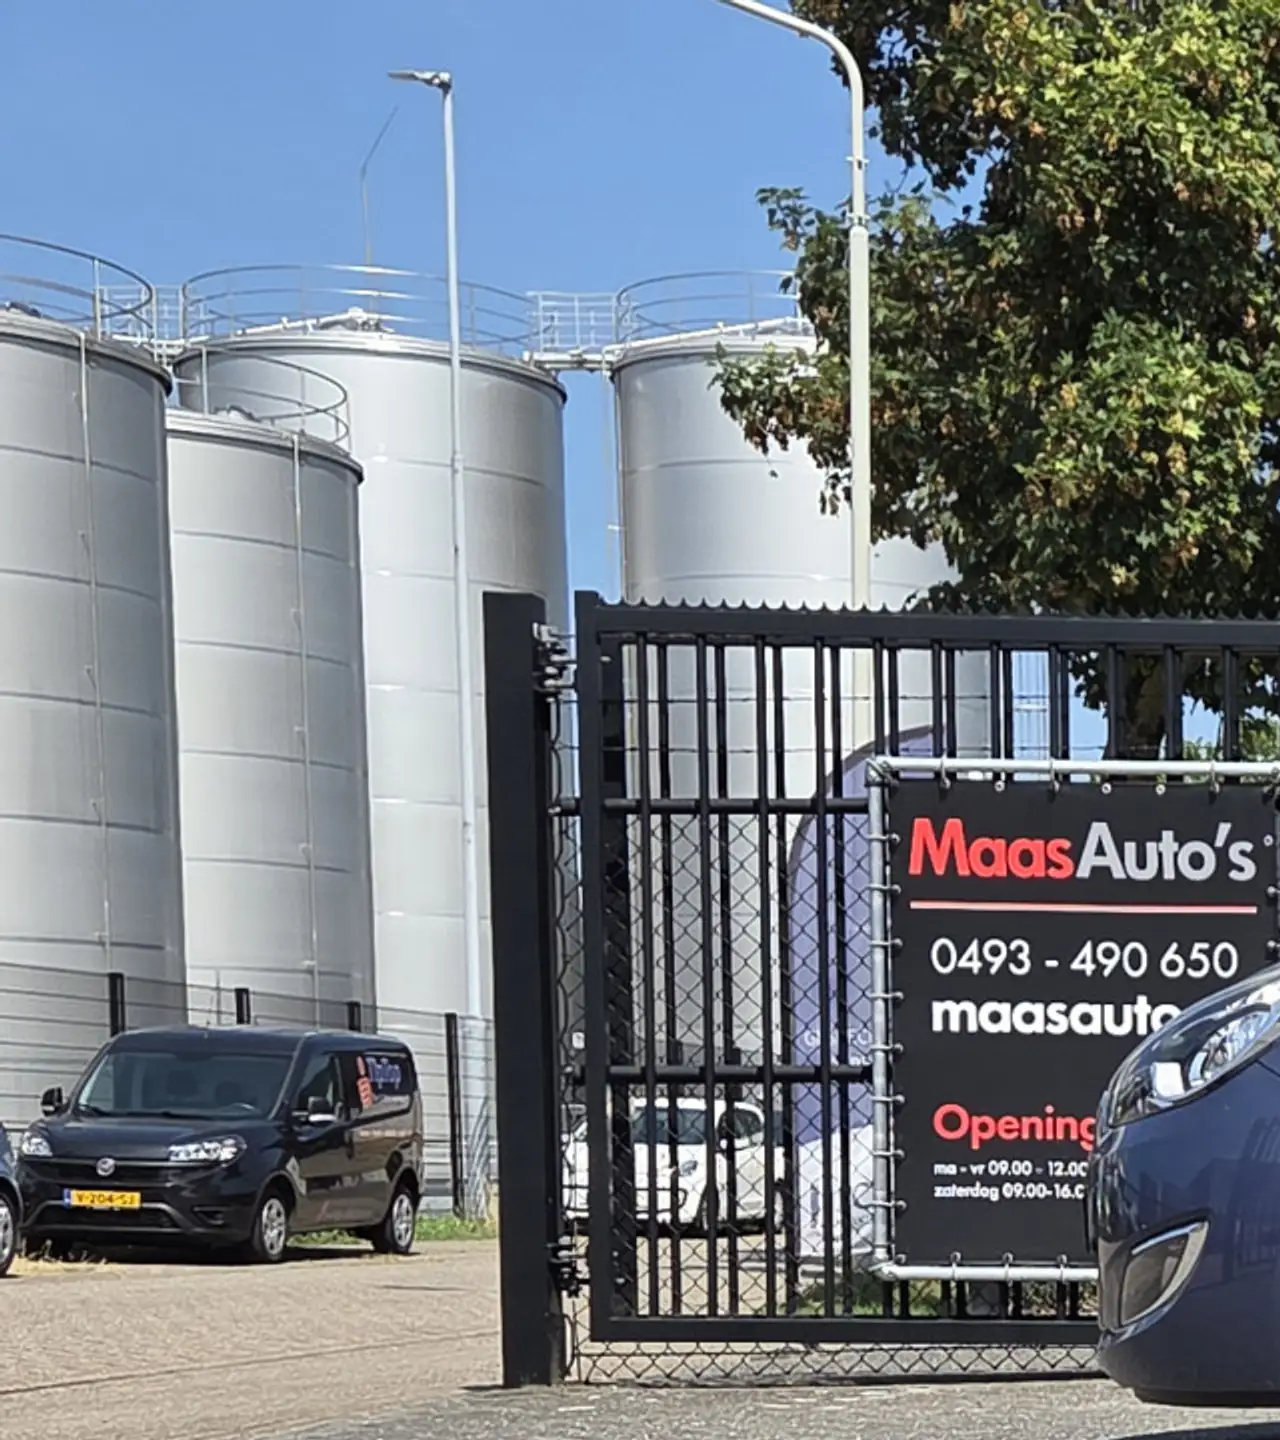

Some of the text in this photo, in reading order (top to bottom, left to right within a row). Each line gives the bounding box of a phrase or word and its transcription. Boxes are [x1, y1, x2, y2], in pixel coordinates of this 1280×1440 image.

[908, 817, 1257, 881] MaasAuto's
[930, 937, 1031, 976] 0493
[1070, 940, 1148, 978] 490
[1160, 942, 1239, 978] 650
[933, 1103, 1096, 1150] Opening
[933, 1163, 957, 1176] ma
[988, 1160, 1033, 1177] 09.00
[934, 1180, 999, 1202] zaterdag
